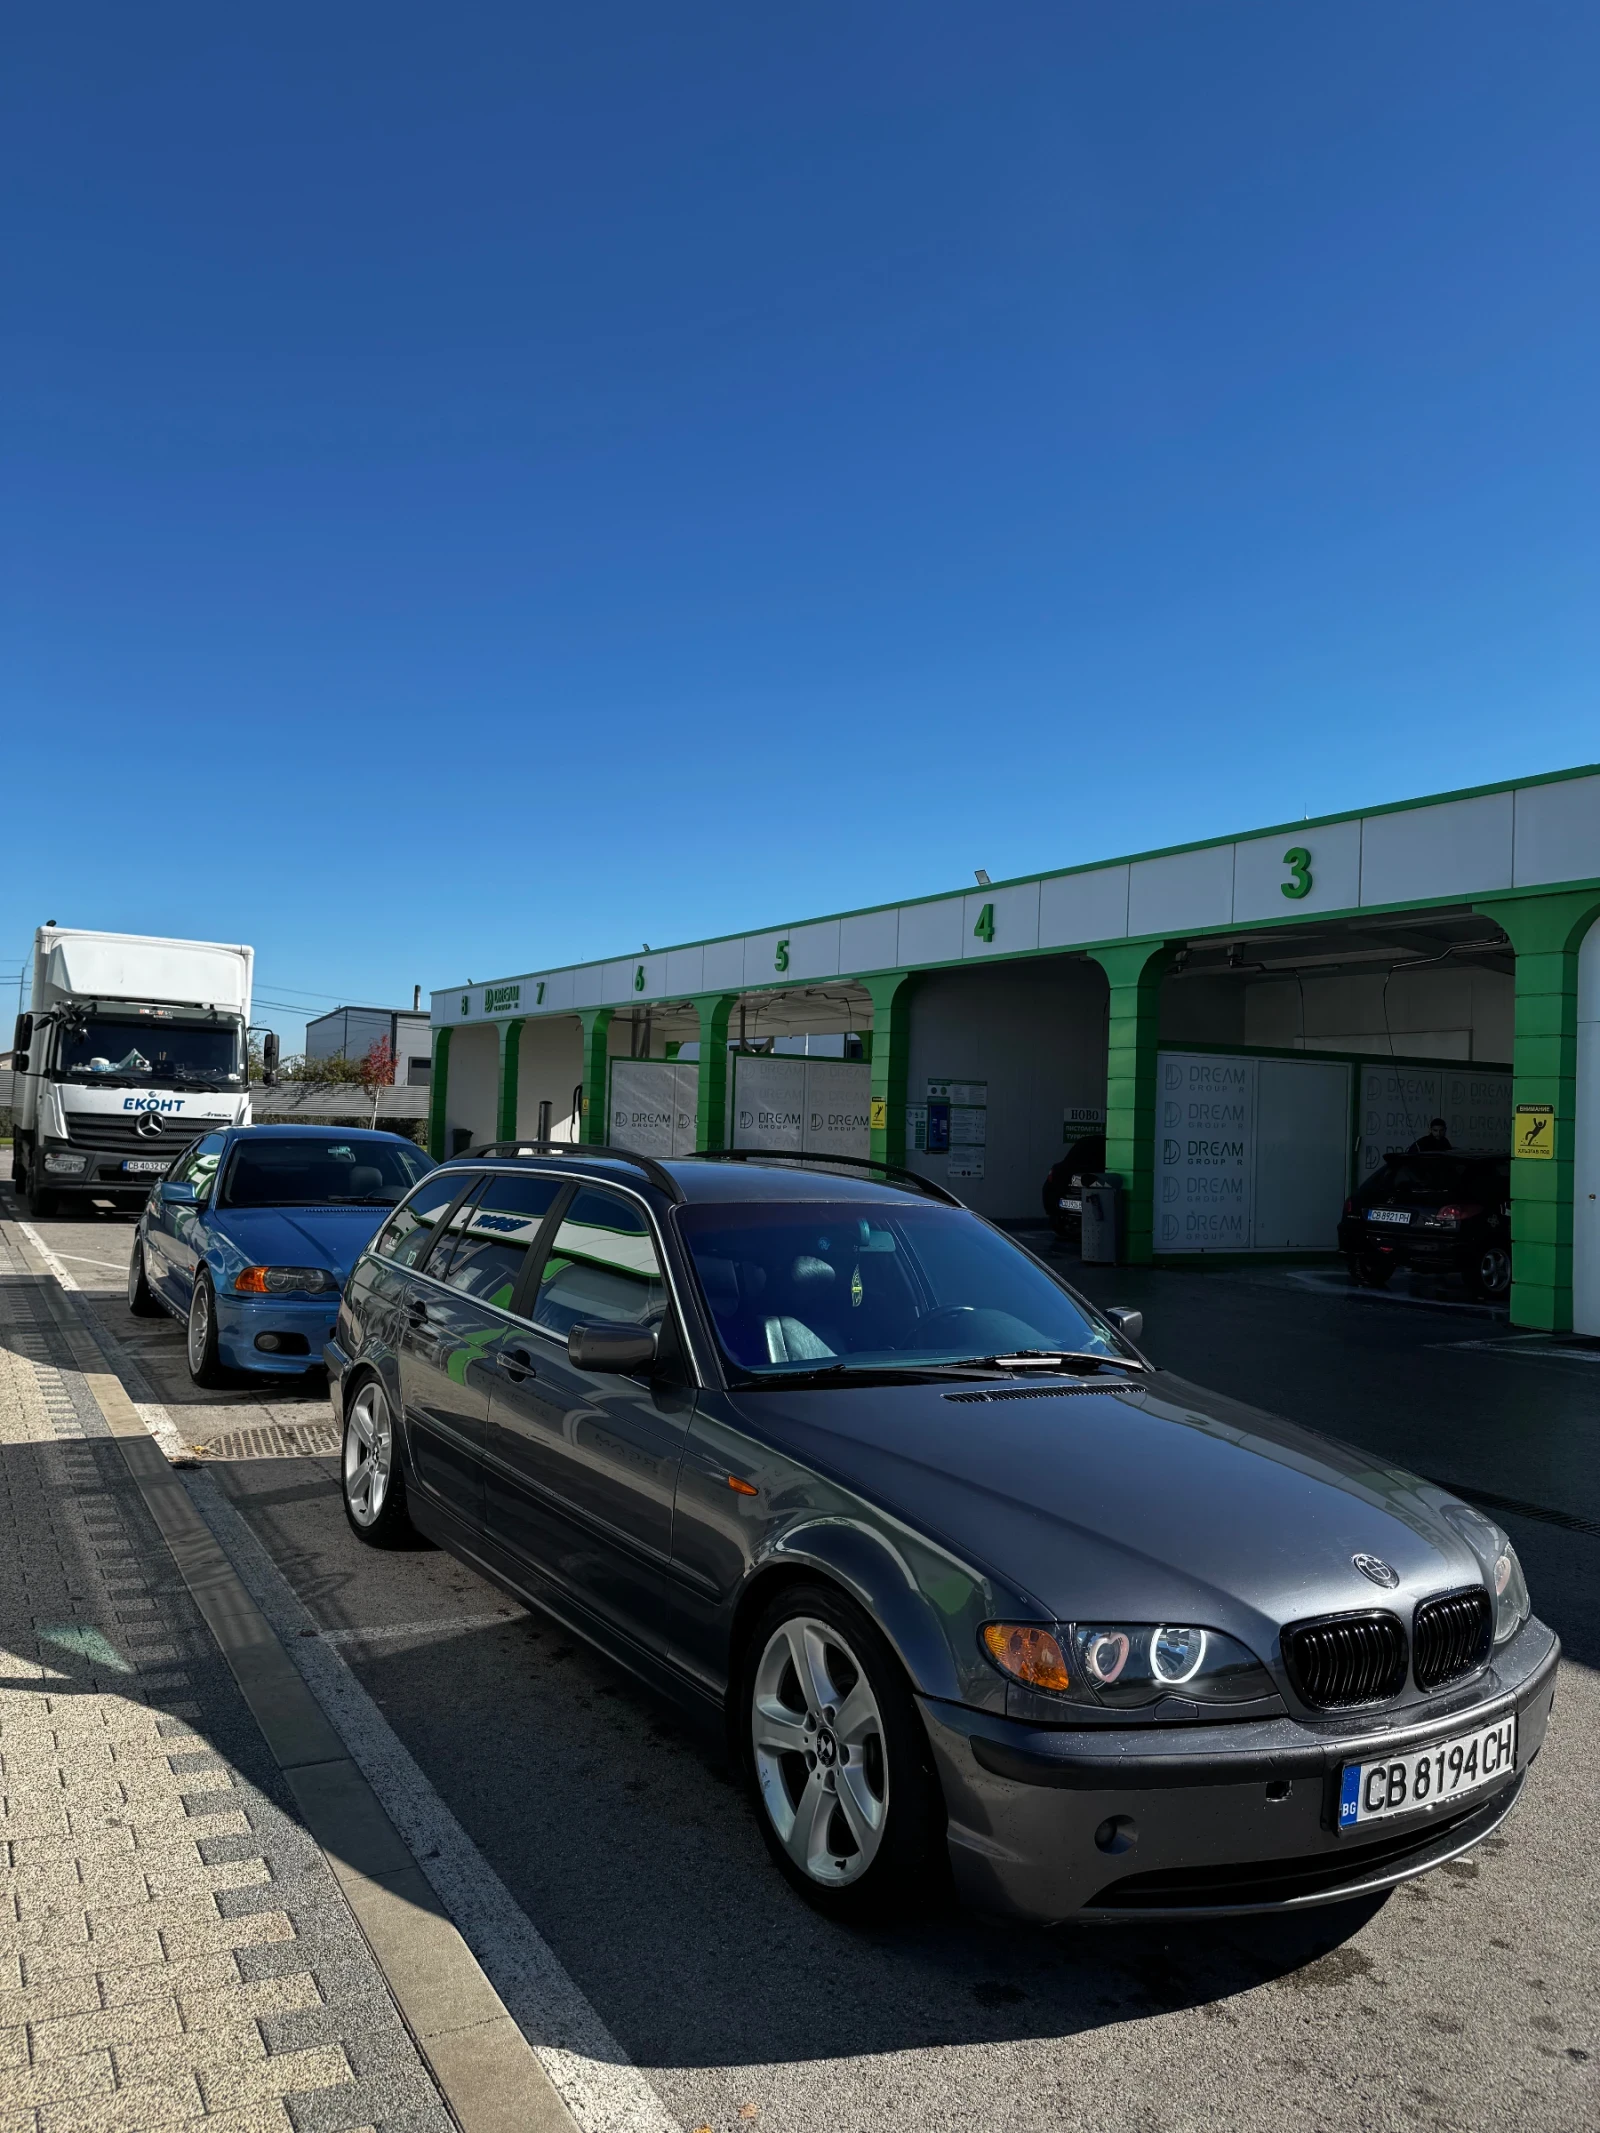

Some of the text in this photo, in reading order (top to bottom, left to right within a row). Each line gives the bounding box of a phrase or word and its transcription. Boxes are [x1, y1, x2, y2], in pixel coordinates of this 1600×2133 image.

[1280, 847, 1313, 899] 3
[974, 903, 995, 943] 4
[774, 940, 789, 972] 5
[634, 965, 645, 992] 6
[536, 982, 545, 1005] 7
[461, 995, 469, 1015] 8
[1190, 1066, 1245, 1084] DREAM
[1189, 1084, 1228, 1092] GROUP
[123, 1098, 185, 1111] ЕКОНТ
[1188, 1103, 1244, 1121] DREAM
[632, 1112, 671, 1123] DREAM
[758, 1112, 800, 1124] DREAM
[828, 1114, 869, 1126] DREAM
[1188, 1121, 1227, 1129] GROUP
[1188, 1141, 1243, 1156] DREAM
[1187, 1178, 1242, 1194] DREAM
[1186, 1215, 1242, 1231] DREAM
[1342, 1801, 1357, 1816] BG
